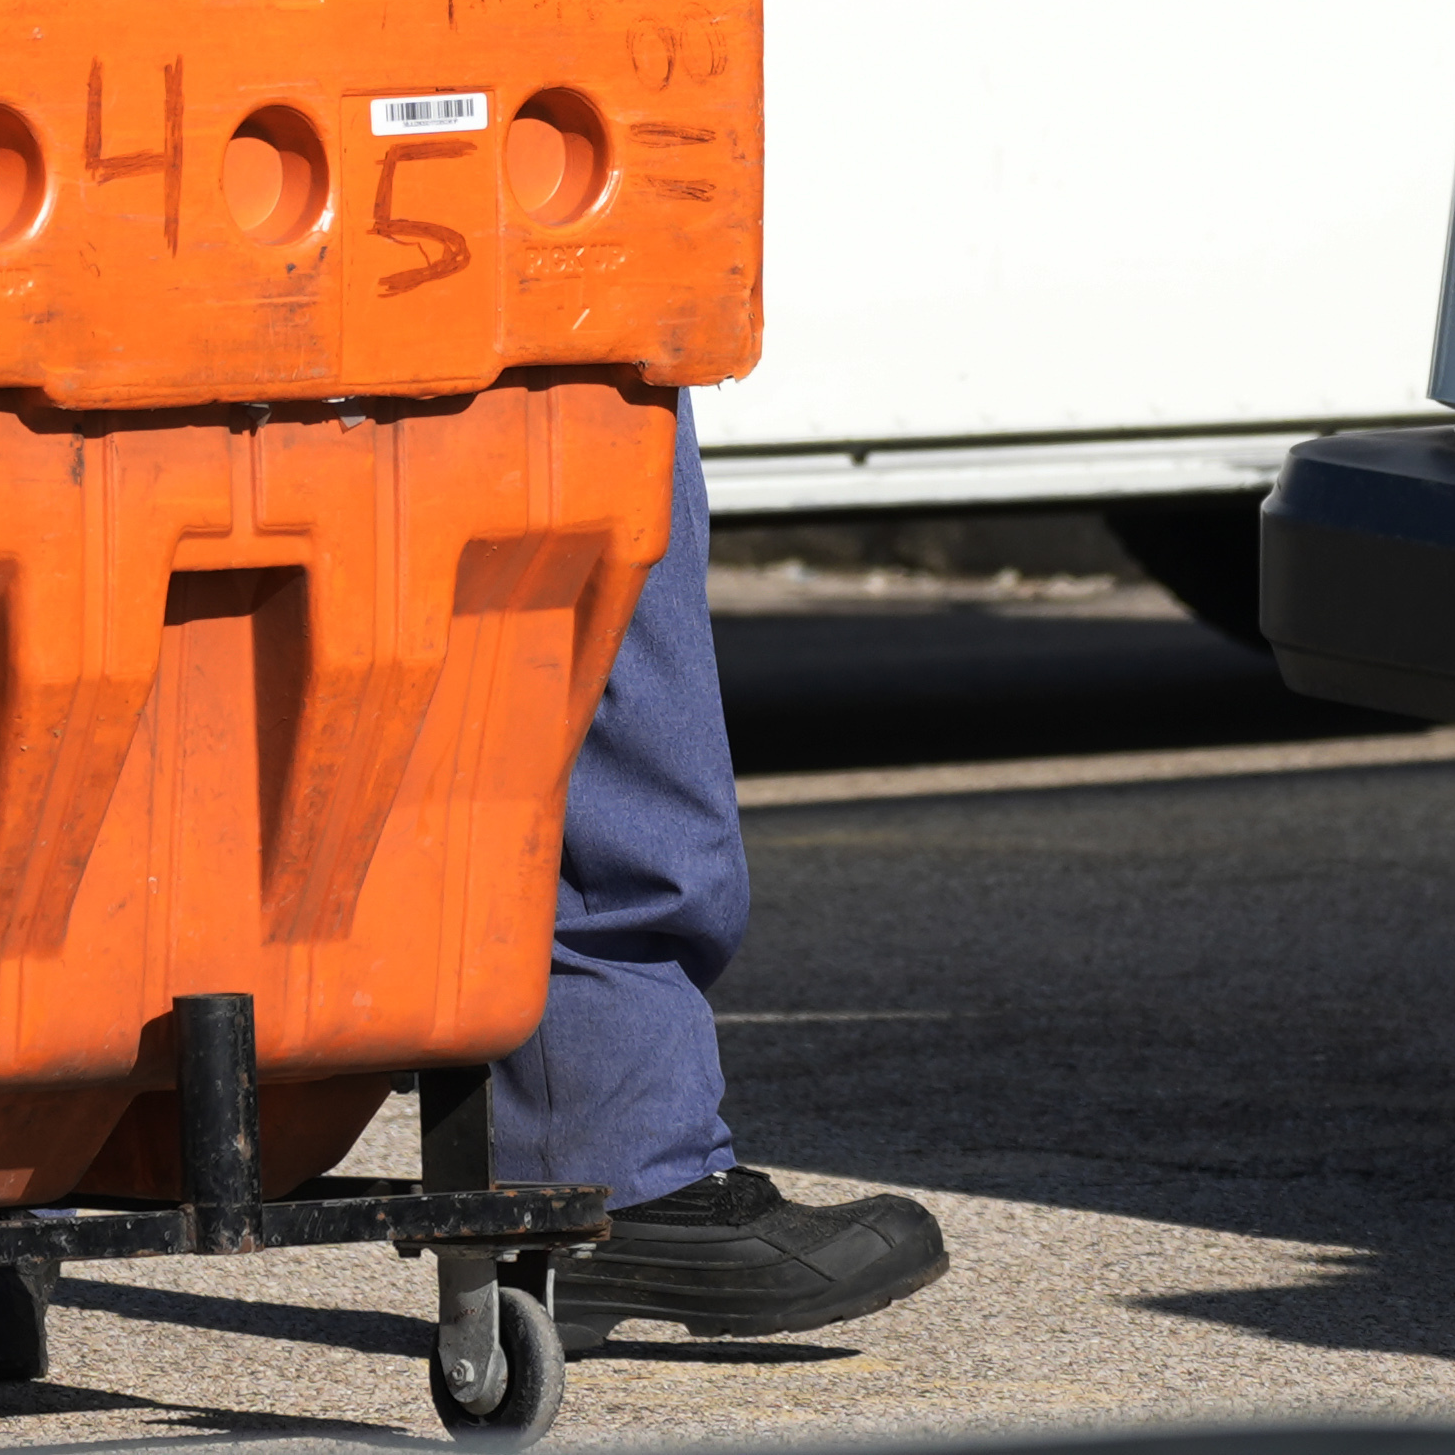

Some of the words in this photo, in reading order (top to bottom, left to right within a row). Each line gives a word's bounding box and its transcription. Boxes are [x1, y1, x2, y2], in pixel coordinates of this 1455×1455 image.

[83, 53, 186, 260] 4
[368, 137, 478, 299] 5
[524, 244, 586, 275] PICK
[589, 242, 627, 273] UP
